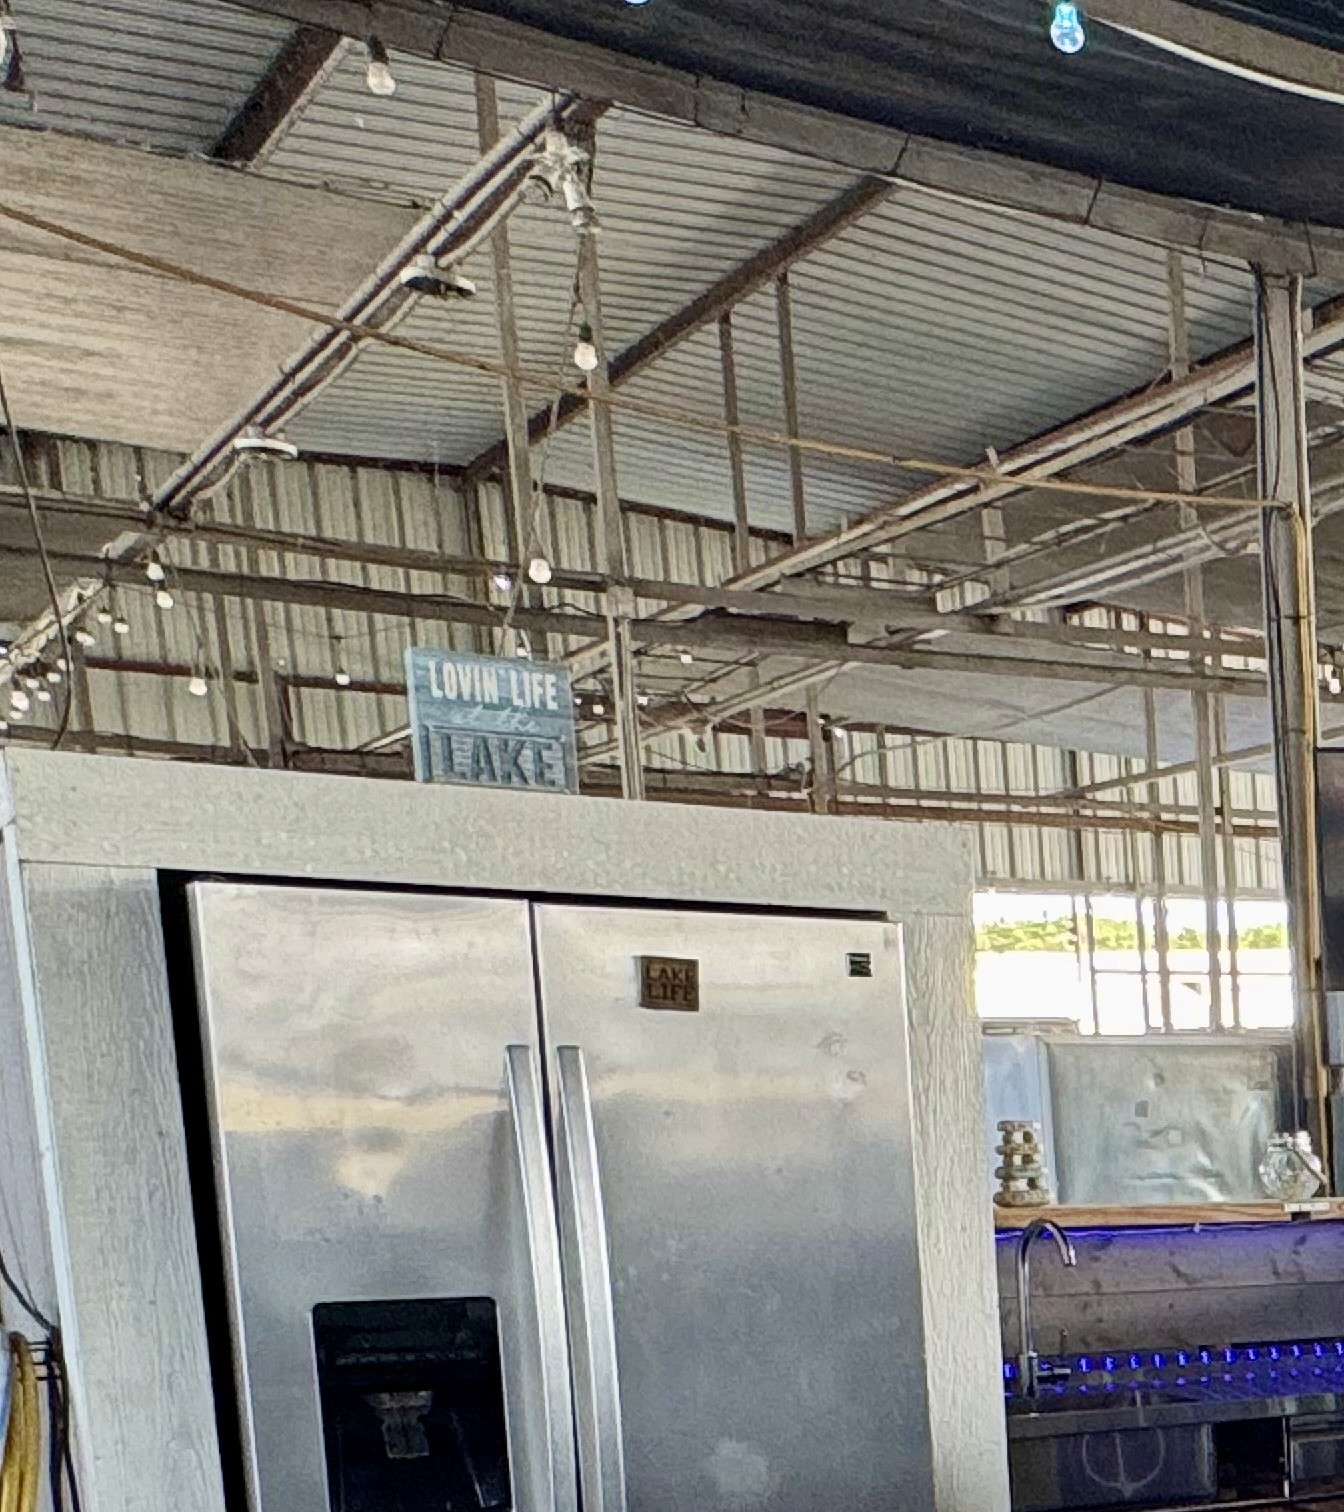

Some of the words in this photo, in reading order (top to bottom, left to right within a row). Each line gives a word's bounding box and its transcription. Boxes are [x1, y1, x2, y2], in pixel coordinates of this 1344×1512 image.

[510, 669, 558, 710] LIFE
[440, 732, 558, 788] LAKE
[645, 960, 696, 984] LAKE
[646, 982, 696, 1002] LIFE
